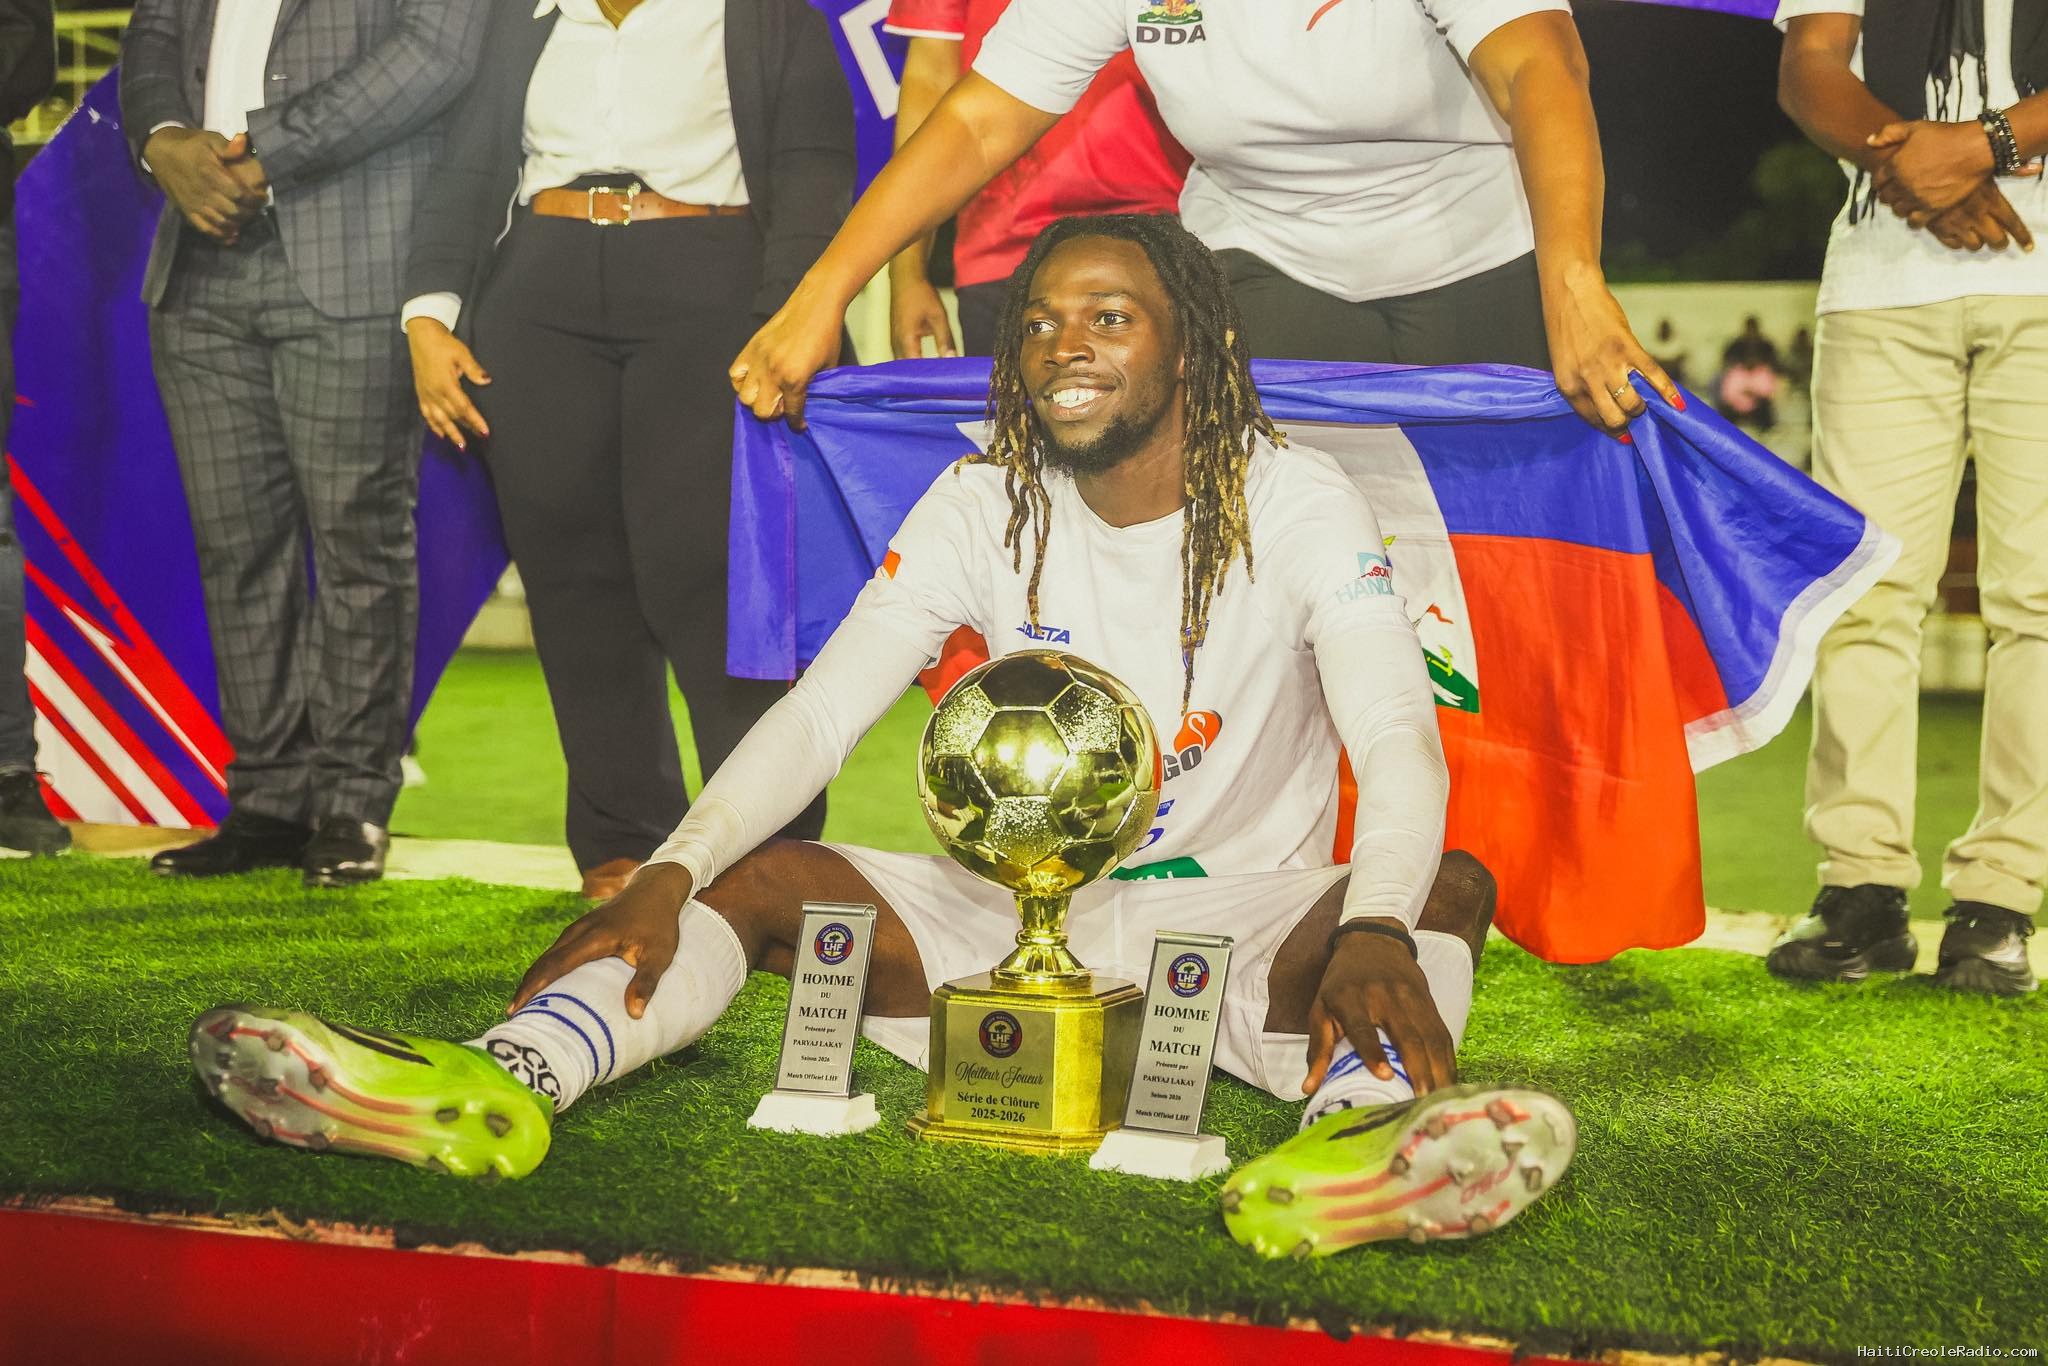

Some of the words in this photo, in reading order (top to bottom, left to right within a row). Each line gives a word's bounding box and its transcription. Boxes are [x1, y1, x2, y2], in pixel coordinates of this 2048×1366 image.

[1136, 24, 1206, 45] DDA
[824, 942, 843, 952] LHF
[802, 973, 855, 987] HOMME
[1178, 973, 1198, 984] LHF
[820, 991, 831, 999] DU
[798, 1006, 847, 1020] MATCH
[1154, 1005, 1210, 1022] HOMME
[1173, 1025, 1185, 1034] DU
[990, 1033, 1010, 1043] LHF
[1149, 1040, 1201, 1056] MATCH
[824, 1074, 839, 1082] LHF
[955, 1061, 1001, 1086] Meilleur
[1001, 1066, 1044, 1089] Joueur
[957, 1092, 983, 1103] Série
[986, 1095, 998, 1105] de
[1001, 1096, 1039, 1109] Clôture
[971, 1107, 1025, 1123] 2025-2026
[1175, 1113, 1190, 1121] LHF
